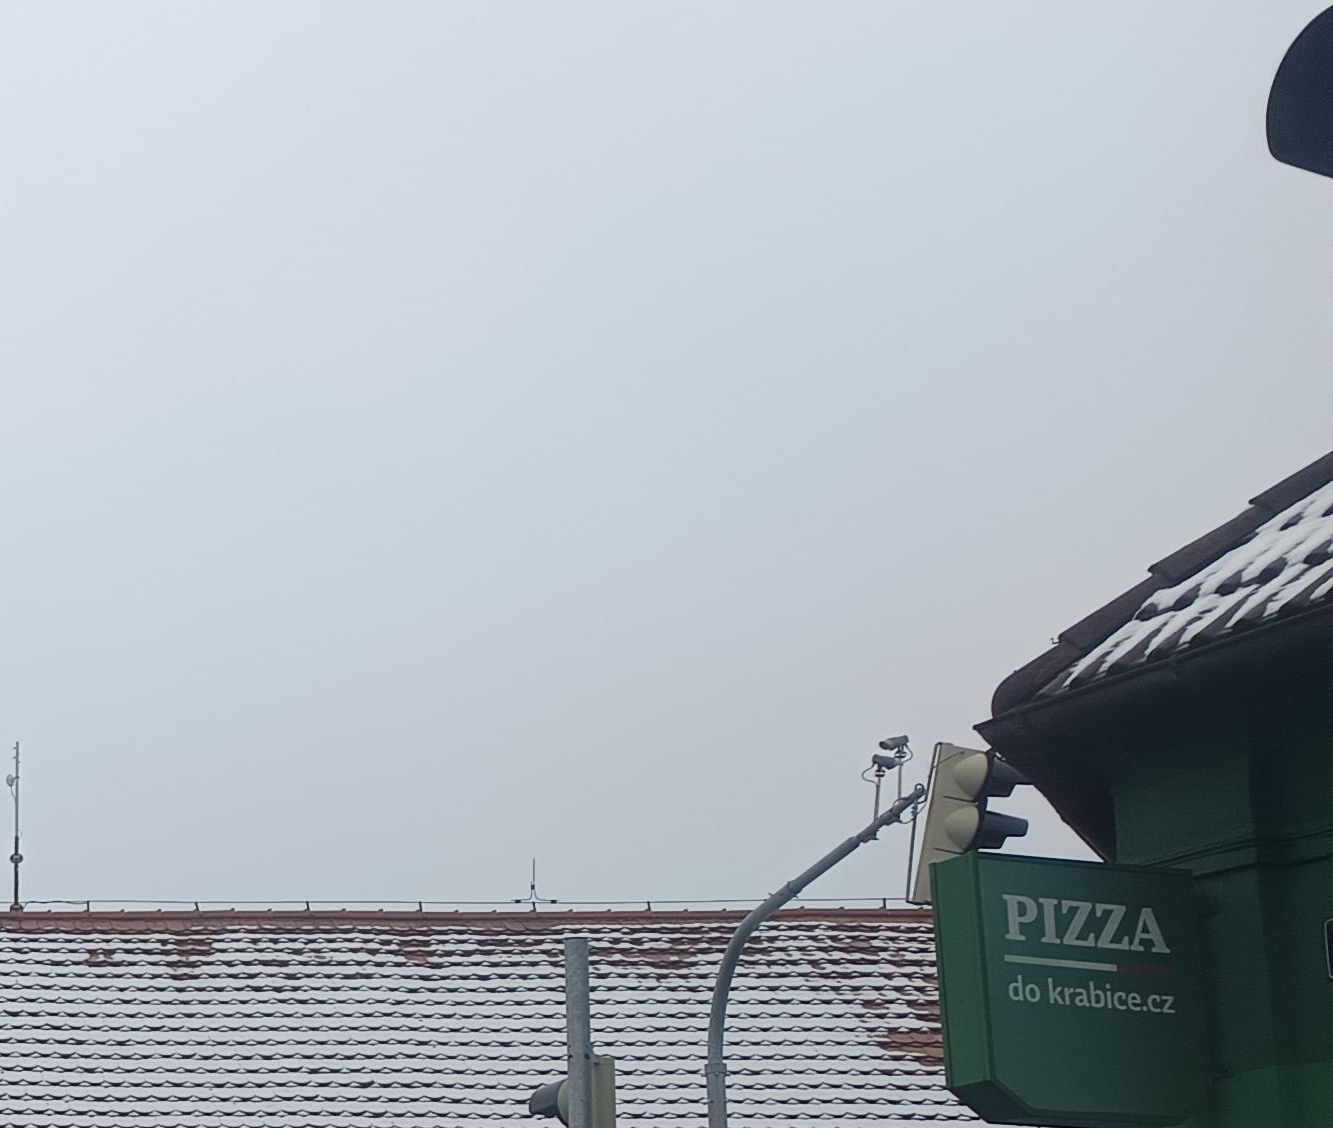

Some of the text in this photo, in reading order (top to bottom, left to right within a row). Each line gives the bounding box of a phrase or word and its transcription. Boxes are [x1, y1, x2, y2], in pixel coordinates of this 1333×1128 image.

[1002, 894, 1171, 953] PIZZA
[1008, 975, 1176, 1014] do krabice.cz
